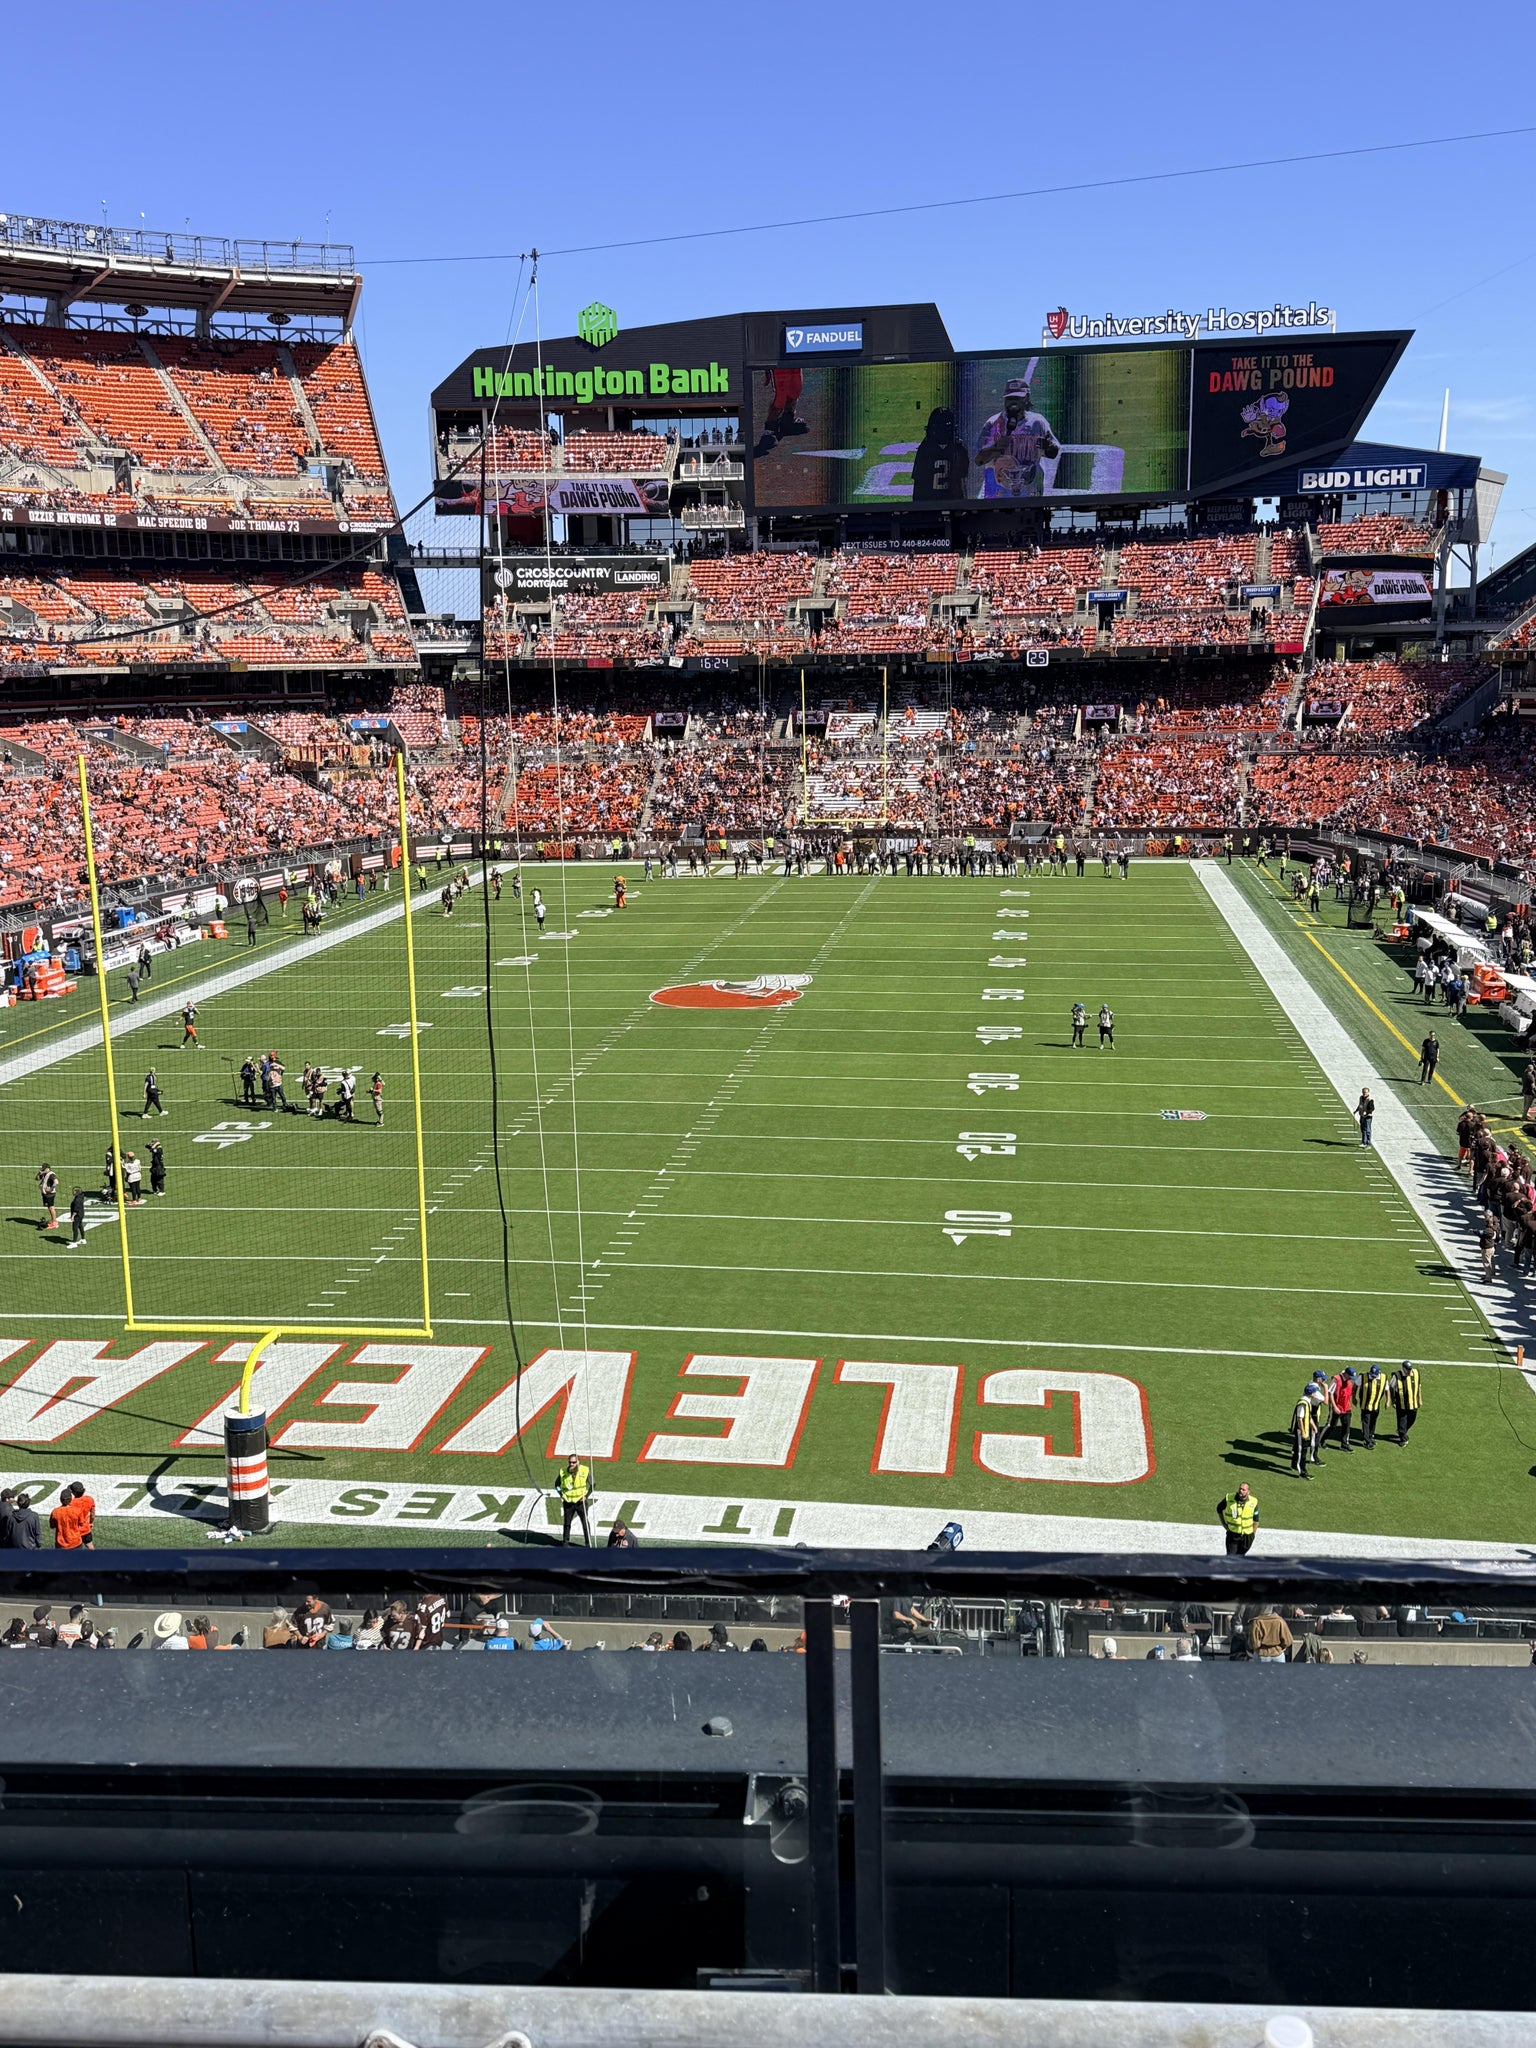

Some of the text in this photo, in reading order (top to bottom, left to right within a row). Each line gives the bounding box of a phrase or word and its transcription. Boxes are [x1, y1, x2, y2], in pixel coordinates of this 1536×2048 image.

[1070, 301, 1329, 338] University Hospitals
[807, 331, 862, 344] FANDUEL
[1232, 354, 1314, 370] TAKE IT TO THE
[473, 362, 728, 403] Huntington Bank
[1209, 367, 1334, 393] DAWG POUND
[932, 459, 949, 490] 2
[1302, 468, 1422, 489] BUD LIGHT
[571, 482, 623, 493] TAKE IT TO THE
[559, 491, 640, 508] DAWG POUND
[1287, 502, 1309, 510] BUD
[1, 508, 13, 521] 76
[28, 510, 117, 526] OZZIE NEWSOME 82
[1283, 509, 1312, 518] LIGHT
[137, 516, 207, 530] MAC SPEEDIE 88
[228, 519, 300, 532] JOE THOMAS 73
[842, 541, 860, 549] TEXT
[862, 540, 887, 549] ISSUES
[890, 540, 900, 548] TO
[516, 567, 658, 582] CROSSCOUNTRY LANDING
[517, 579, 569, 588] MORTGAGE
[1374, 584, 1427, 595] DAWG POUND
[700, 658, 729, 669] 16:24
[1030, 652, 1046, 664] 25
[440, 985, 493, 997] 50
[981, 988, 1025, 1000] 50
[975, 1026, 1023, 1040] 40
[966, 1072, 1021, 1091] 30
[192, 1121, 273, 1143] 20
[956, 1132, 1017, 1156] 20
[942, 1209, 1013, 1237] 10
[0, 1338, 1155, 1486] CLEVELA
[702, 1503, 797, 1537] IT
[431, 1607, 446, 1634] 84
[389, 1631, 412, 1649] 73
